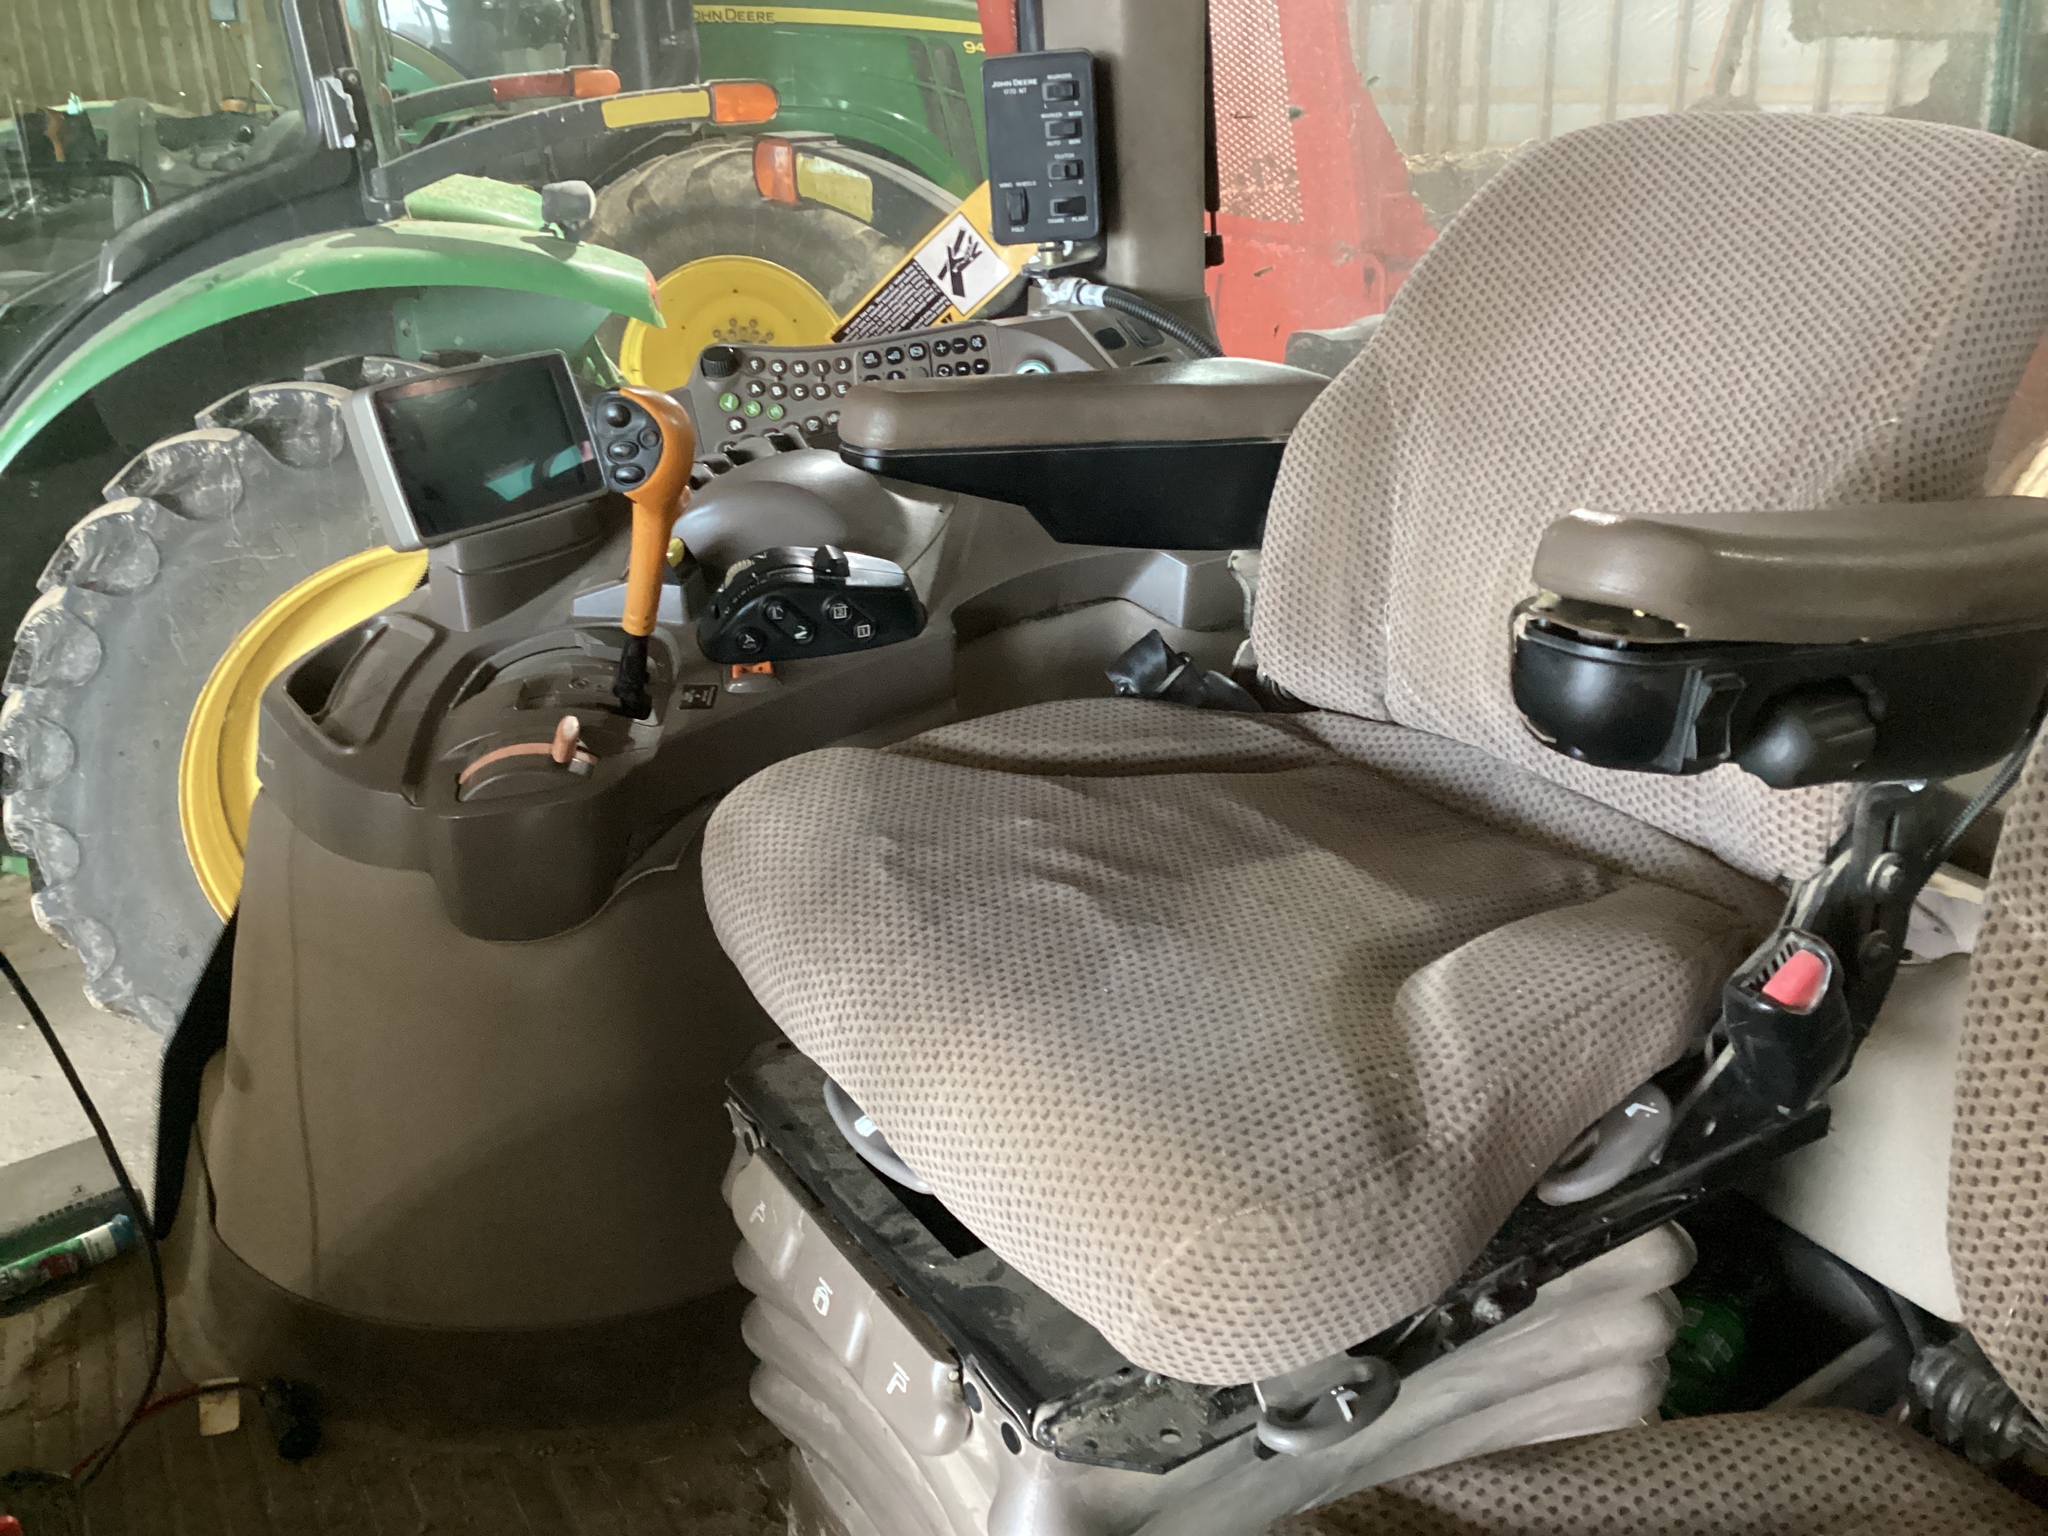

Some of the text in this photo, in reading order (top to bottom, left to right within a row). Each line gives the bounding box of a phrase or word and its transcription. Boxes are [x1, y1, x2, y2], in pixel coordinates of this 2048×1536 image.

[694, 8, 775, 22] OHN DEERE
[750, 360, 758, 370] F
[772, 363, 782, 372] G
[794, 363, 804, 373] H
[839, 360, 847, 370] J
[751, 384, 847, 397] A B C D E
